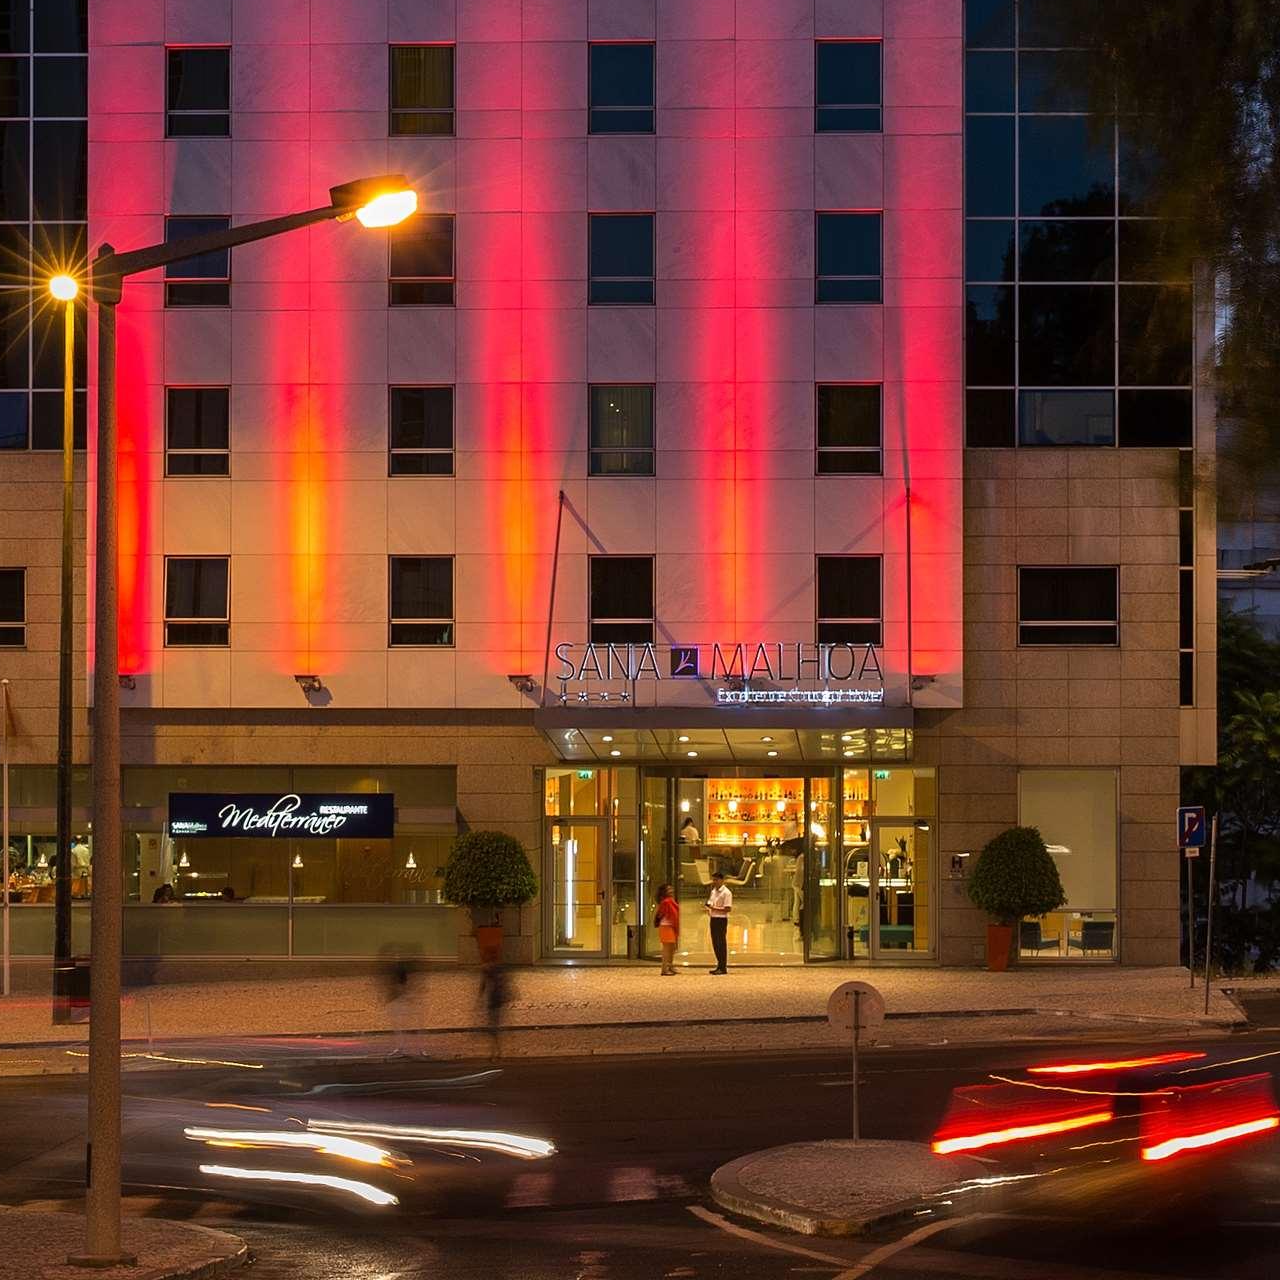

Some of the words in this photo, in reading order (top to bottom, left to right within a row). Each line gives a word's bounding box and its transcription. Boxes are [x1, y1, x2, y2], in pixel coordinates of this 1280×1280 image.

[555, 642, 661, 681] SANA
[712, 642, 884, 681] MALHOA
[218, 794, 347, 837] Mediterrâneo
